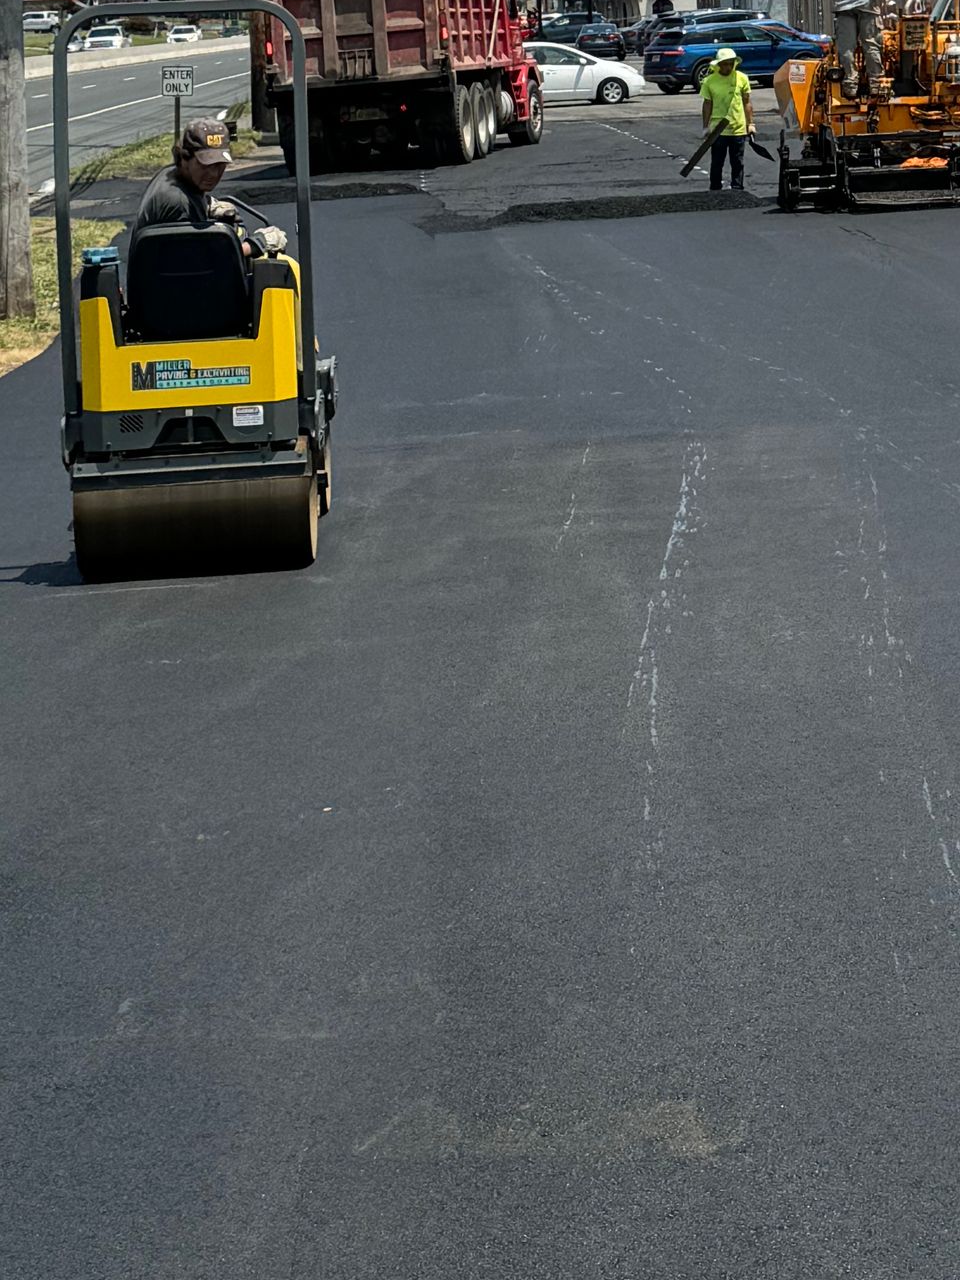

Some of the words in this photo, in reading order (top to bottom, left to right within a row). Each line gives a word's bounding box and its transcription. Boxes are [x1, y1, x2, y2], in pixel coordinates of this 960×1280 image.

[163, 70, 192, 80] ENTER
[165, 83, 190, 93] ONLY
[206, 134, 224, 146] CAT
[156, 360, 191, 371] MILLER
[156, 370, 189, 380] PAVING
